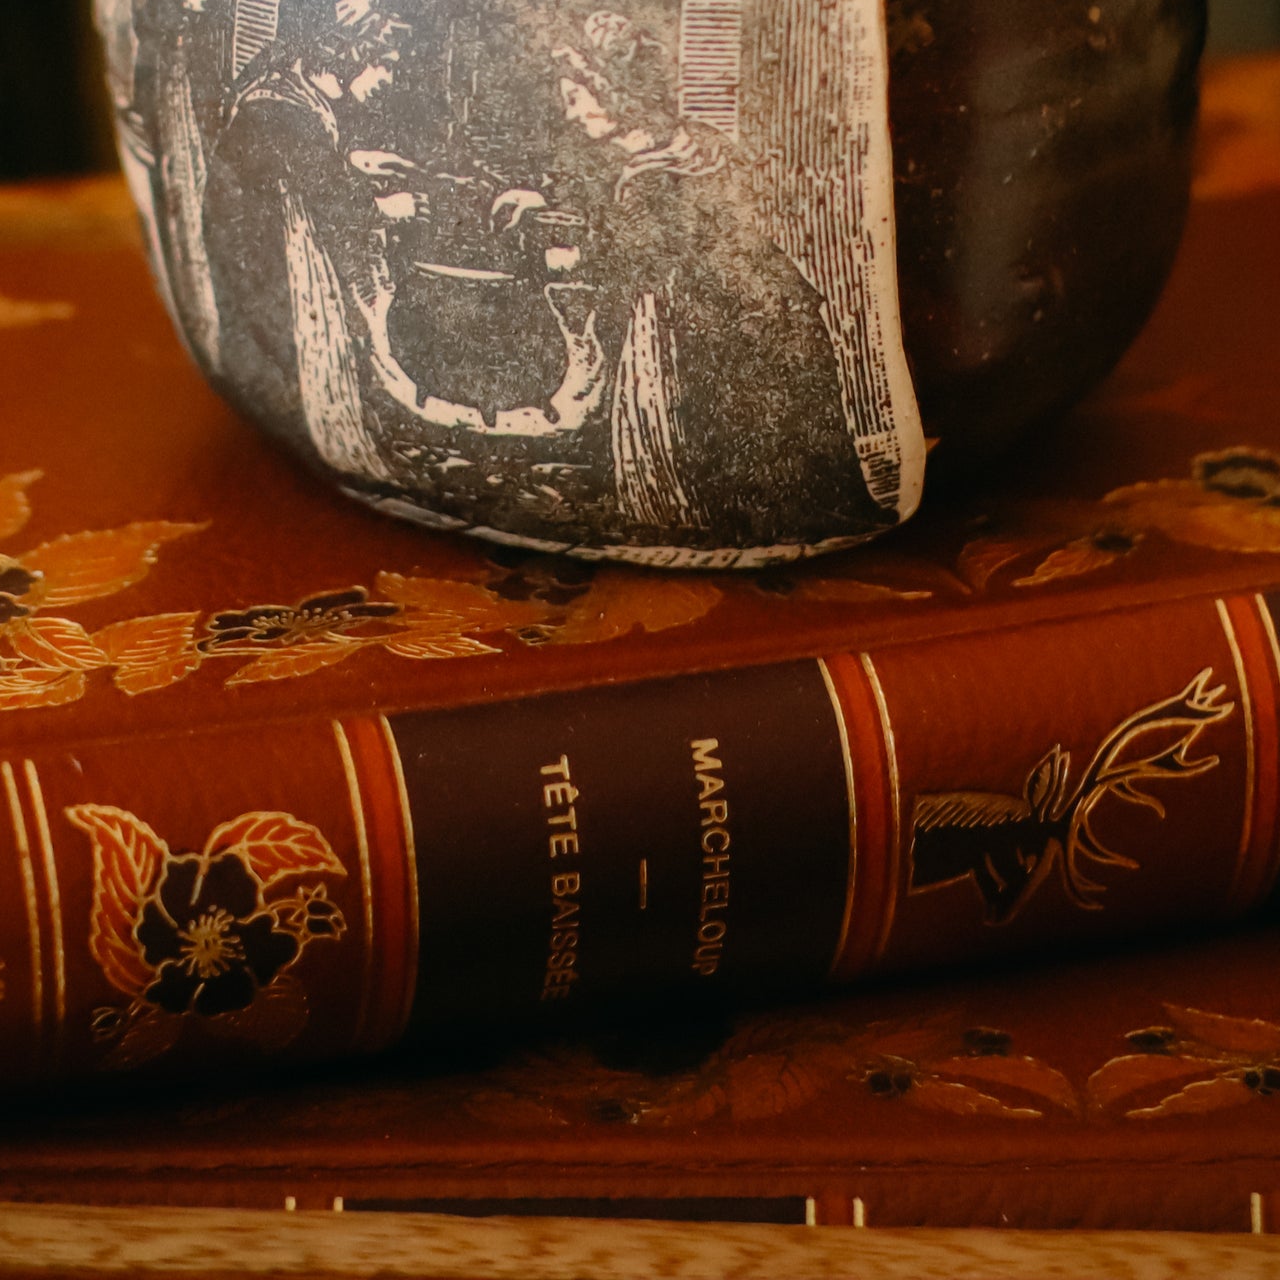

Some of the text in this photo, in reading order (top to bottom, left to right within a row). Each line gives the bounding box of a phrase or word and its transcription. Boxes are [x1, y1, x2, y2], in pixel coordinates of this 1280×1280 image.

[540, 753, 582, 1001] TÊTE BAISSÉE
[690, 737, 731, 977] MARCHELOUP
